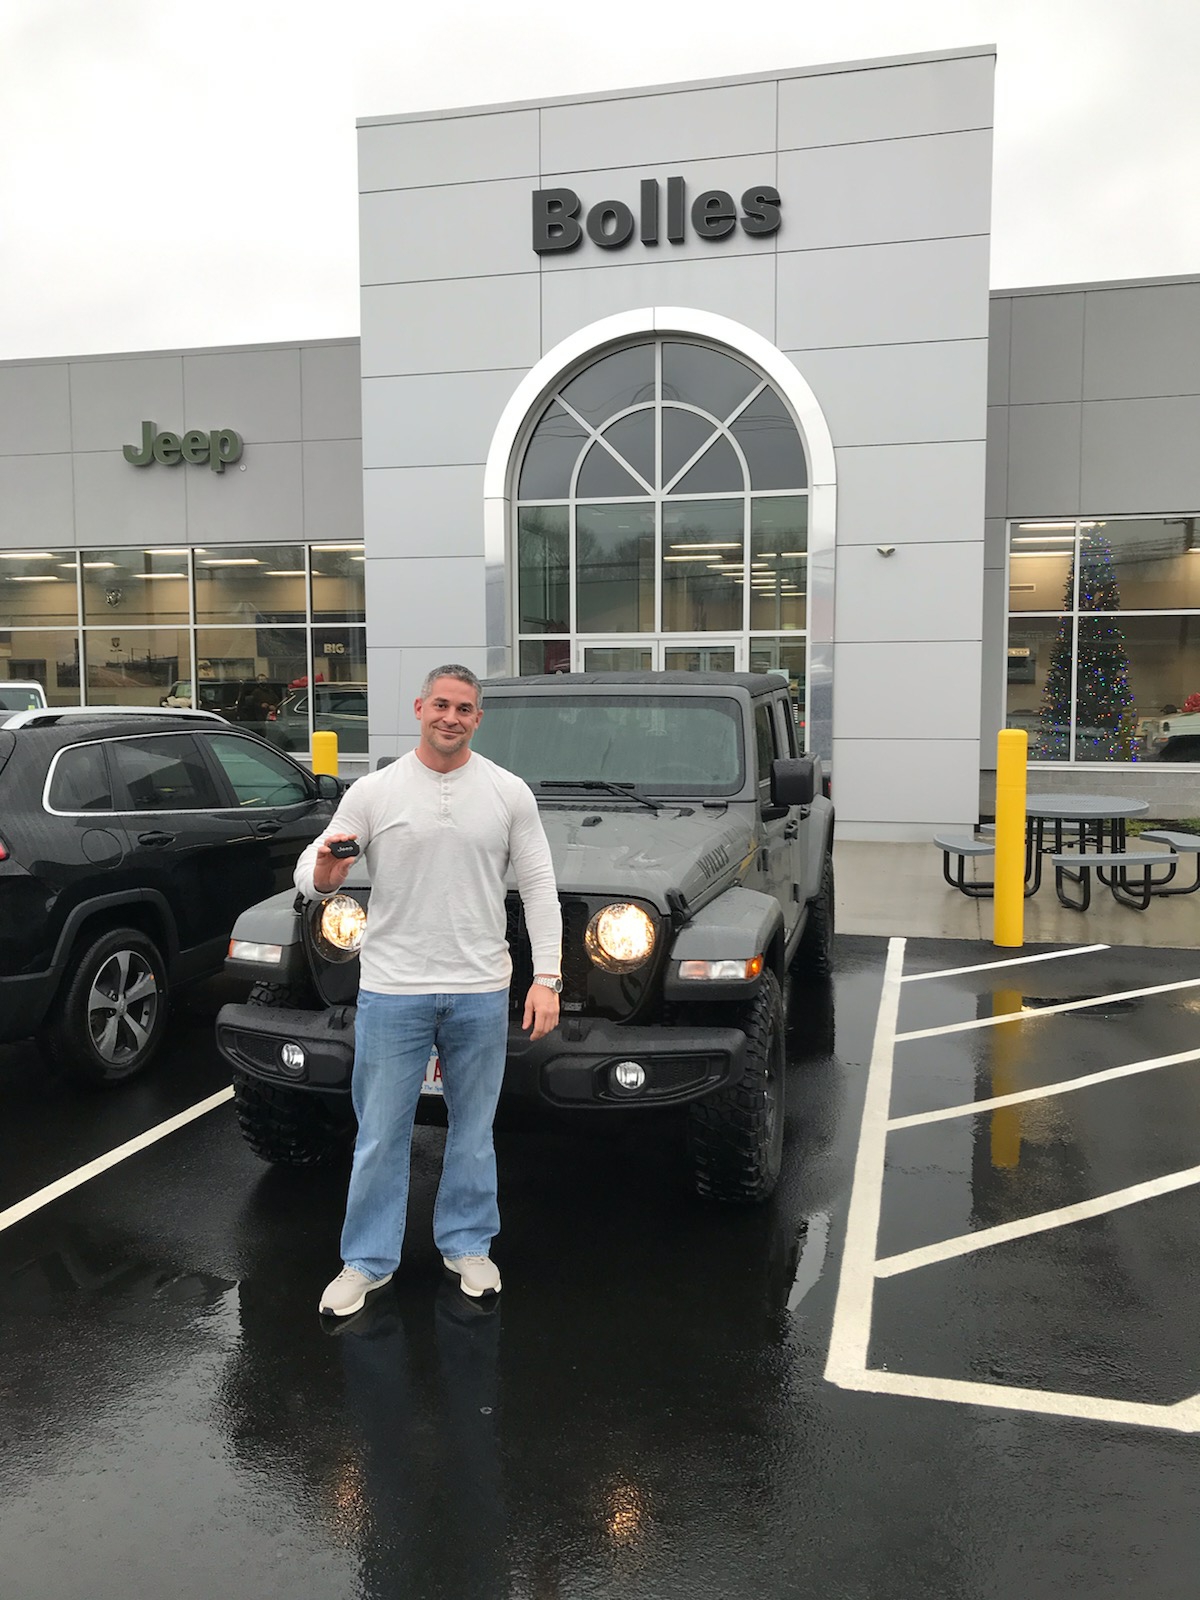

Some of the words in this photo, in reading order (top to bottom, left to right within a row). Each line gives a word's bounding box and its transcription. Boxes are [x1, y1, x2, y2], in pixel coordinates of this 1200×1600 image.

[532, 176, 782, 255] Bolles
[122, 420, 243, 474] Jeep
[323, 643, 345, 654] BIG
